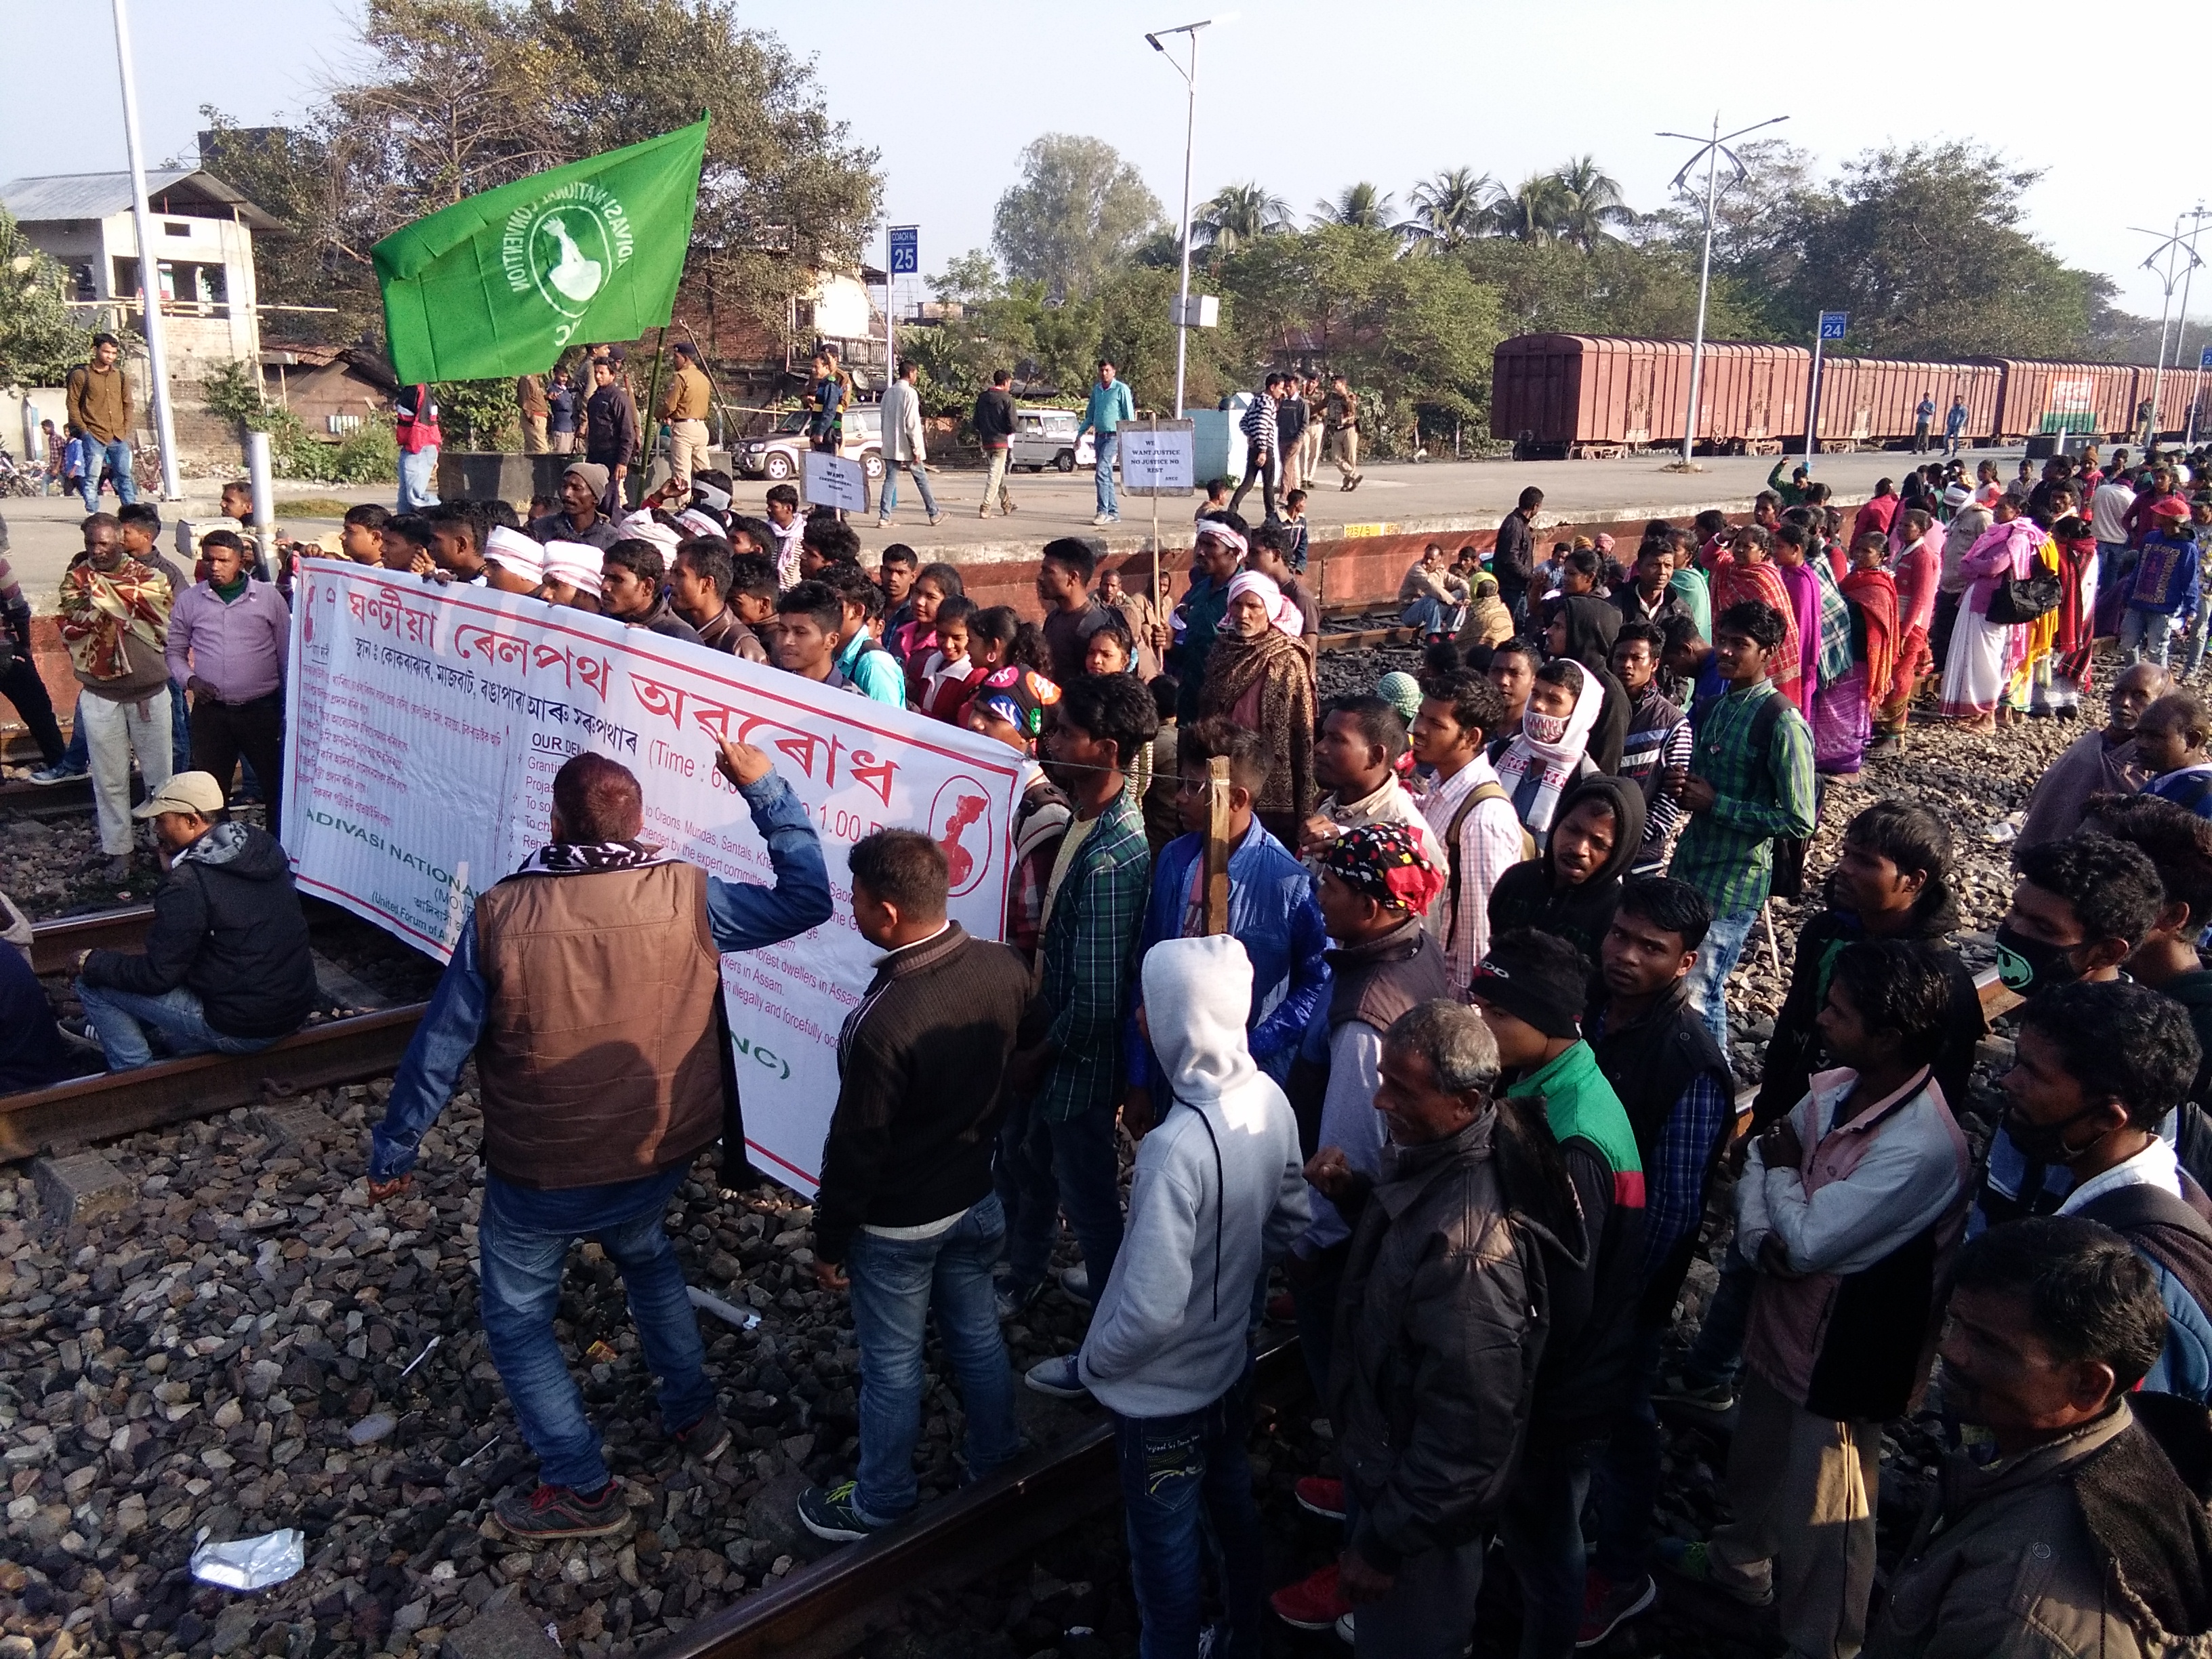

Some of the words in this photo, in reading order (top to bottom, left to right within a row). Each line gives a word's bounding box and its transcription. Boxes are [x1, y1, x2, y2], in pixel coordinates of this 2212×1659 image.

[895, 248, 914, 270] 25
[1824, 324, 1841, 337] 24
[454, 623, 614, 704] ৰেলপথ
[527, 695, 569, 724] আৰু
[532, 733, 562, 751] OUR
[528, 756, 564, 774] Grantin
[525, 795, 537, 809] To
[649, 739, 695, 778] (Time
[819, 804, 861, 842] 1.00
[306, 808, 384, 851] ADIVASI
[525, 815, 535, 829] To
[670, 837, 680, 857] by
[682, 842, 695, 859] the
[697, 852, 722, 874] expert
[721, 835, 754, 864] Santals,
[372, 890, 398, 914] (United
[401, 907, 427, 931] Forum
[428, 926, 437, 936] of
[438, 930, 449, 943] All
[721, 954, 741, 974] rkers
[743, 966, 751, 978] in
[753, 968, 784, 996] Assam.
[781, 960, 817, 988] dwellers
[819, 977, 827, 994] in
[733, 985, 764, 1012] illegally
[765, 1001, 781, 1019] and
[783, 1008, 823, 1044] forcefully
